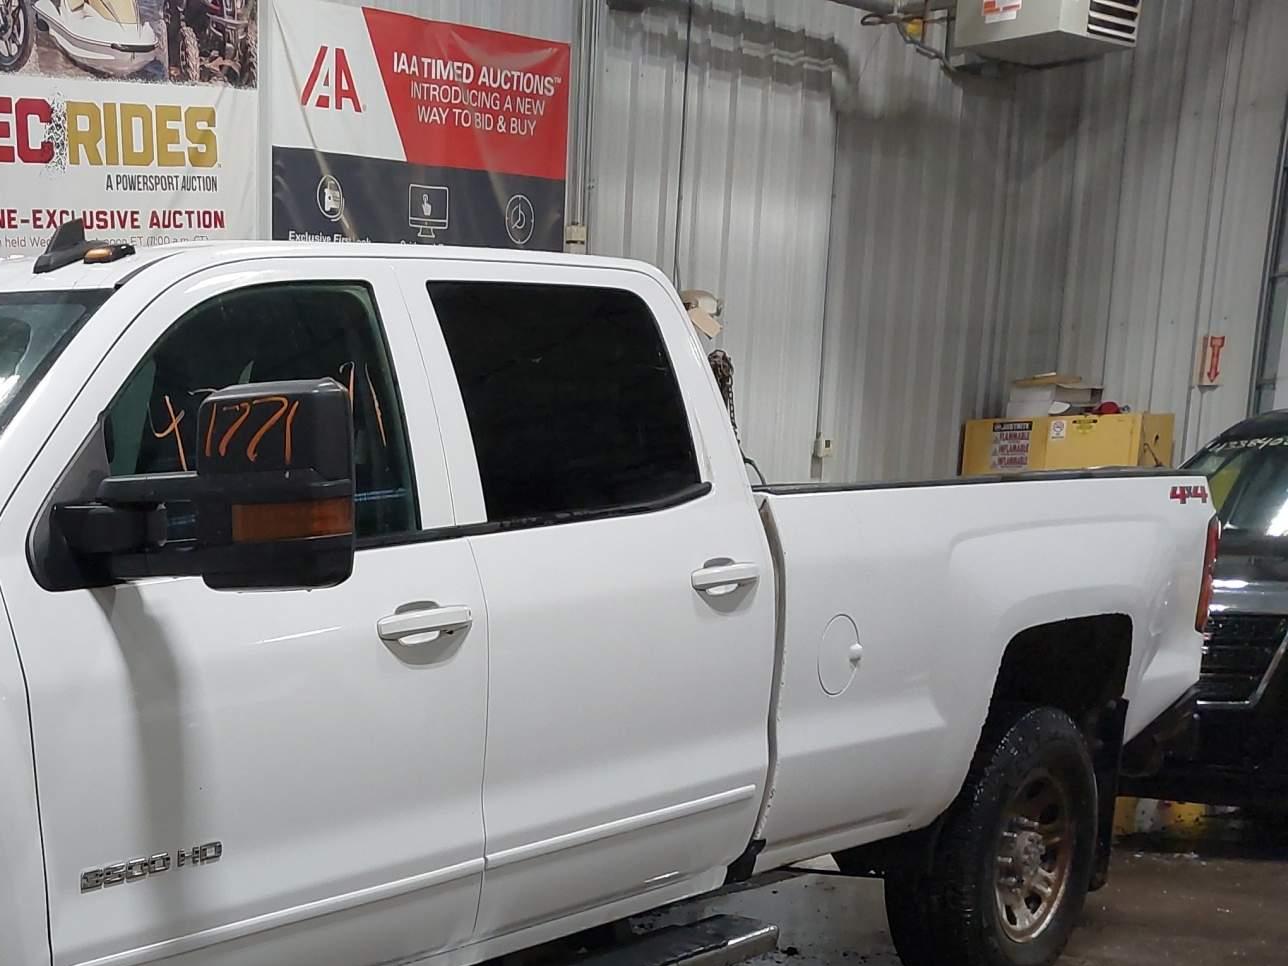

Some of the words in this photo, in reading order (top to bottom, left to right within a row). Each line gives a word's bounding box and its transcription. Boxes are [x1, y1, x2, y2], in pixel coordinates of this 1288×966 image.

[393, 52, 419, 76] IAA
[421, 58, 474, 83] TIMED
[410, 80, 500, 110] INTRODUCING
[503, 95, 512, 112] A
[516, 97, 545, 116] NEW
[417, 105, 449, 125] WAY
[453, 109, 472, 127] TO
[475, 113, 494, 131] BID
[497, 116, 506, 133] &
[510, 118, 536, 136] BUY
[105, 174, 113, 191] A
[116, 175, 179, 192] POWERSPORT
[181, 176, 218, 193] AUCTION
[149, 210, 225, 229] AUCTION
[5, 236, 28, 248] held
[130, 236, 144, 247] ET
[288, 230, 333, 242] Exclusive
